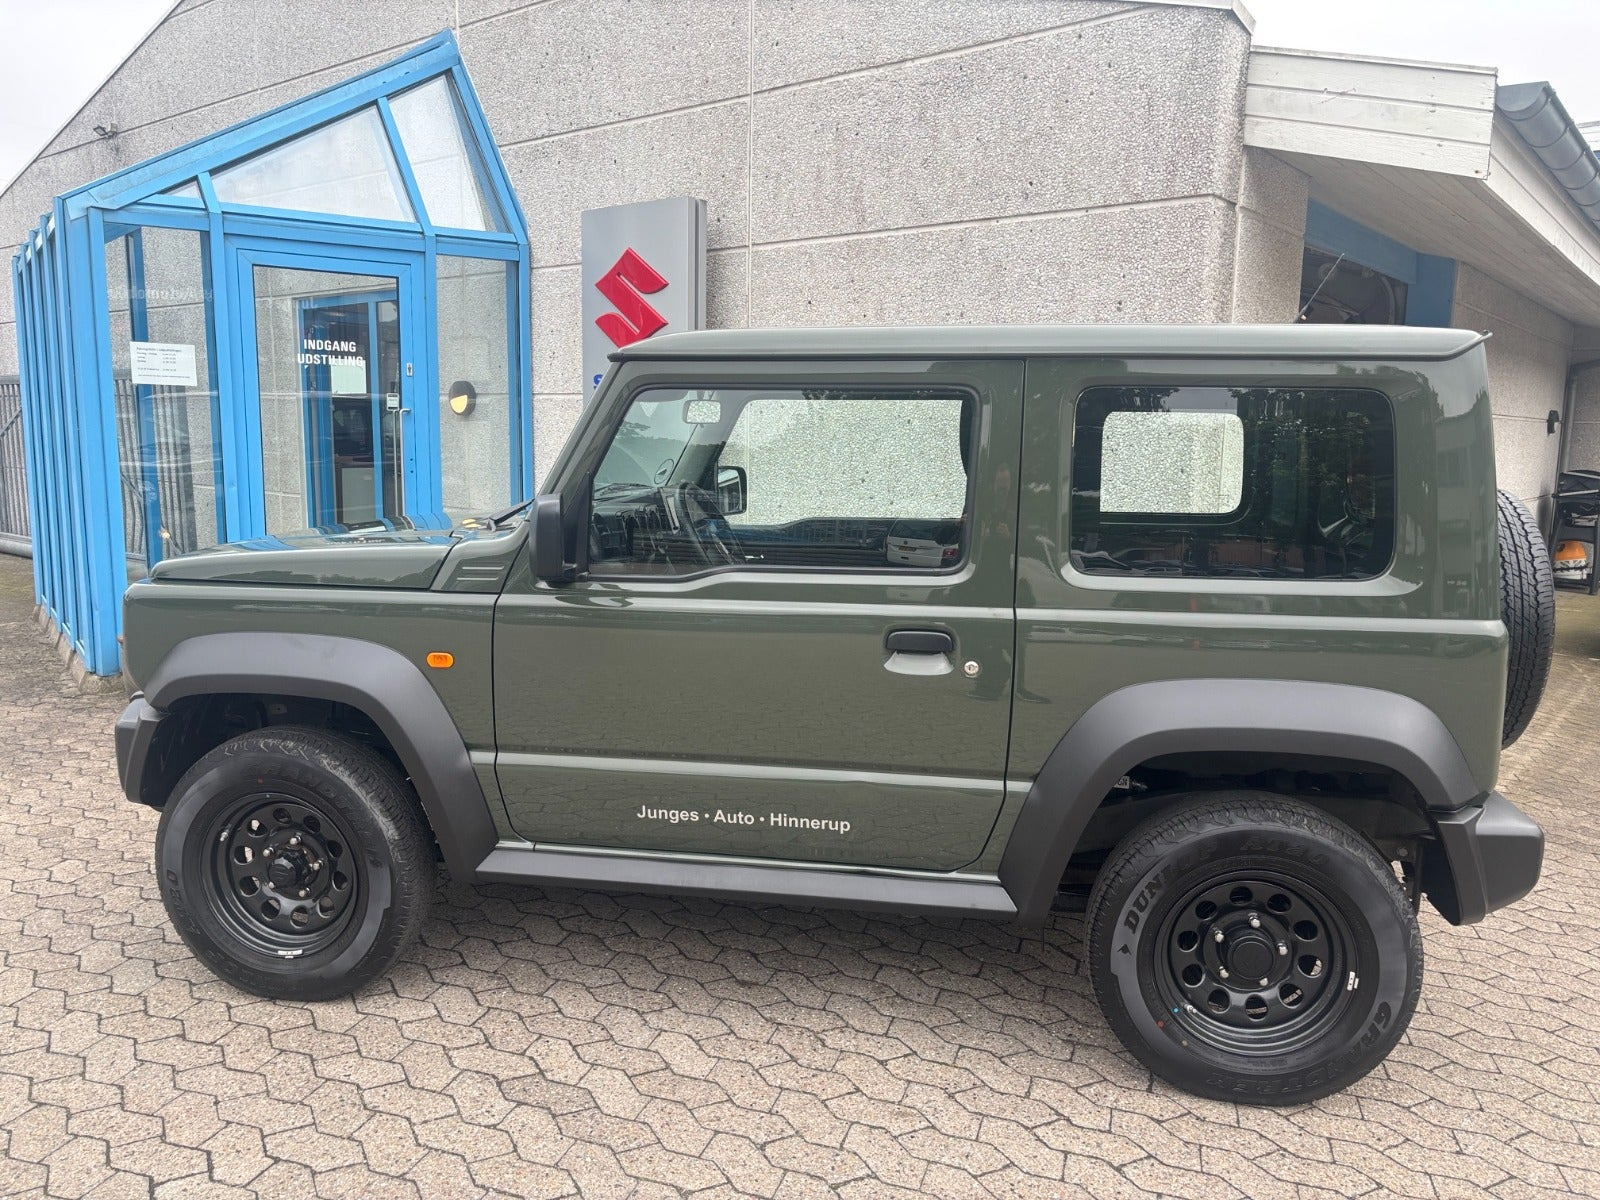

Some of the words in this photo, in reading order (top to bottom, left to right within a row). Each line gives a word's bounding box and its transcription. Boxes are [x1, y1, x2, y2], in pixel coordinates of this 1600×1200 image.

[303, 339, 357, 353] INDGANG
[297, 353, 364, 367] UDSTILLING
[636, 805, 699, 824] Junges
[713, 809, 755, 825] Auto
[770, 813, 851, 834] Hinnerup
